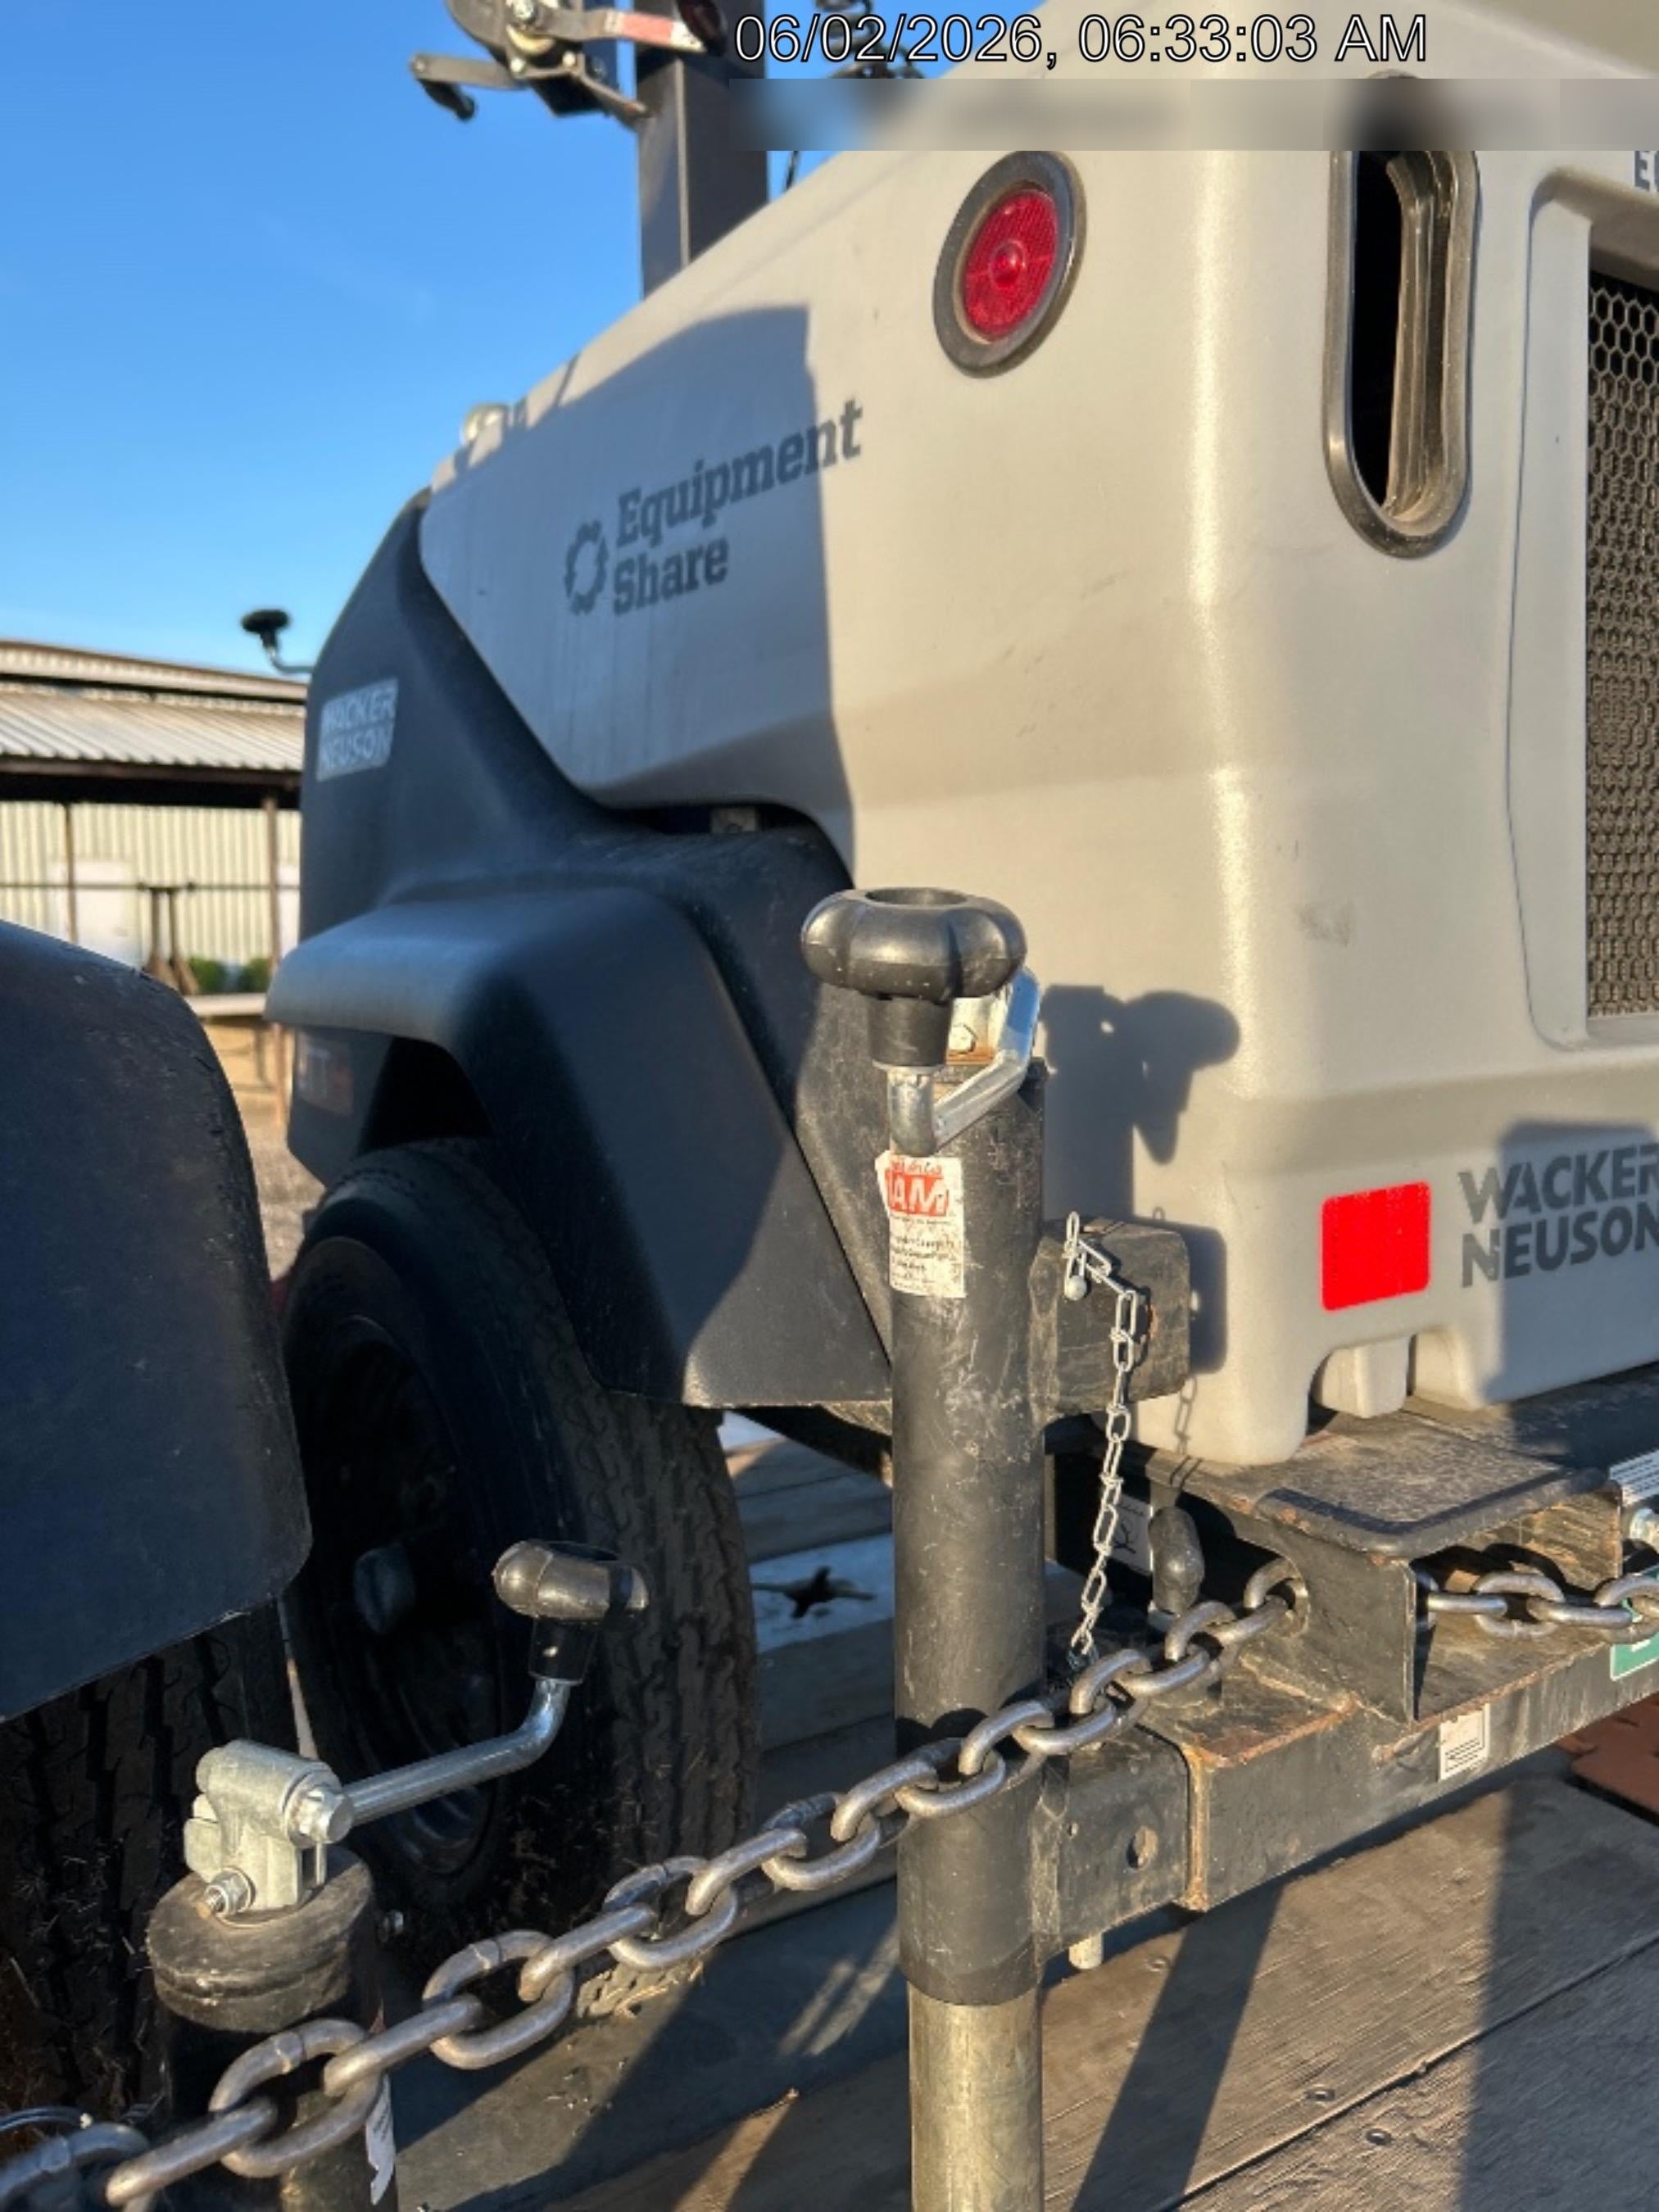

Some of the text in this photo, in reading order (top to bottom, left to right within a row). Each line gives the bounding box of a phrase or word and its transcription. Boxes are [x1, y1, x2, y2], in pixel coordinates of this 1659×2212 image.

[616, 398, 863, 548] Equipment
[613, 537, 728, 615] Share
[1457, 1143, 1659, 1225] WACKER
[1462, 1201, 1659, 1289] NEUSON
